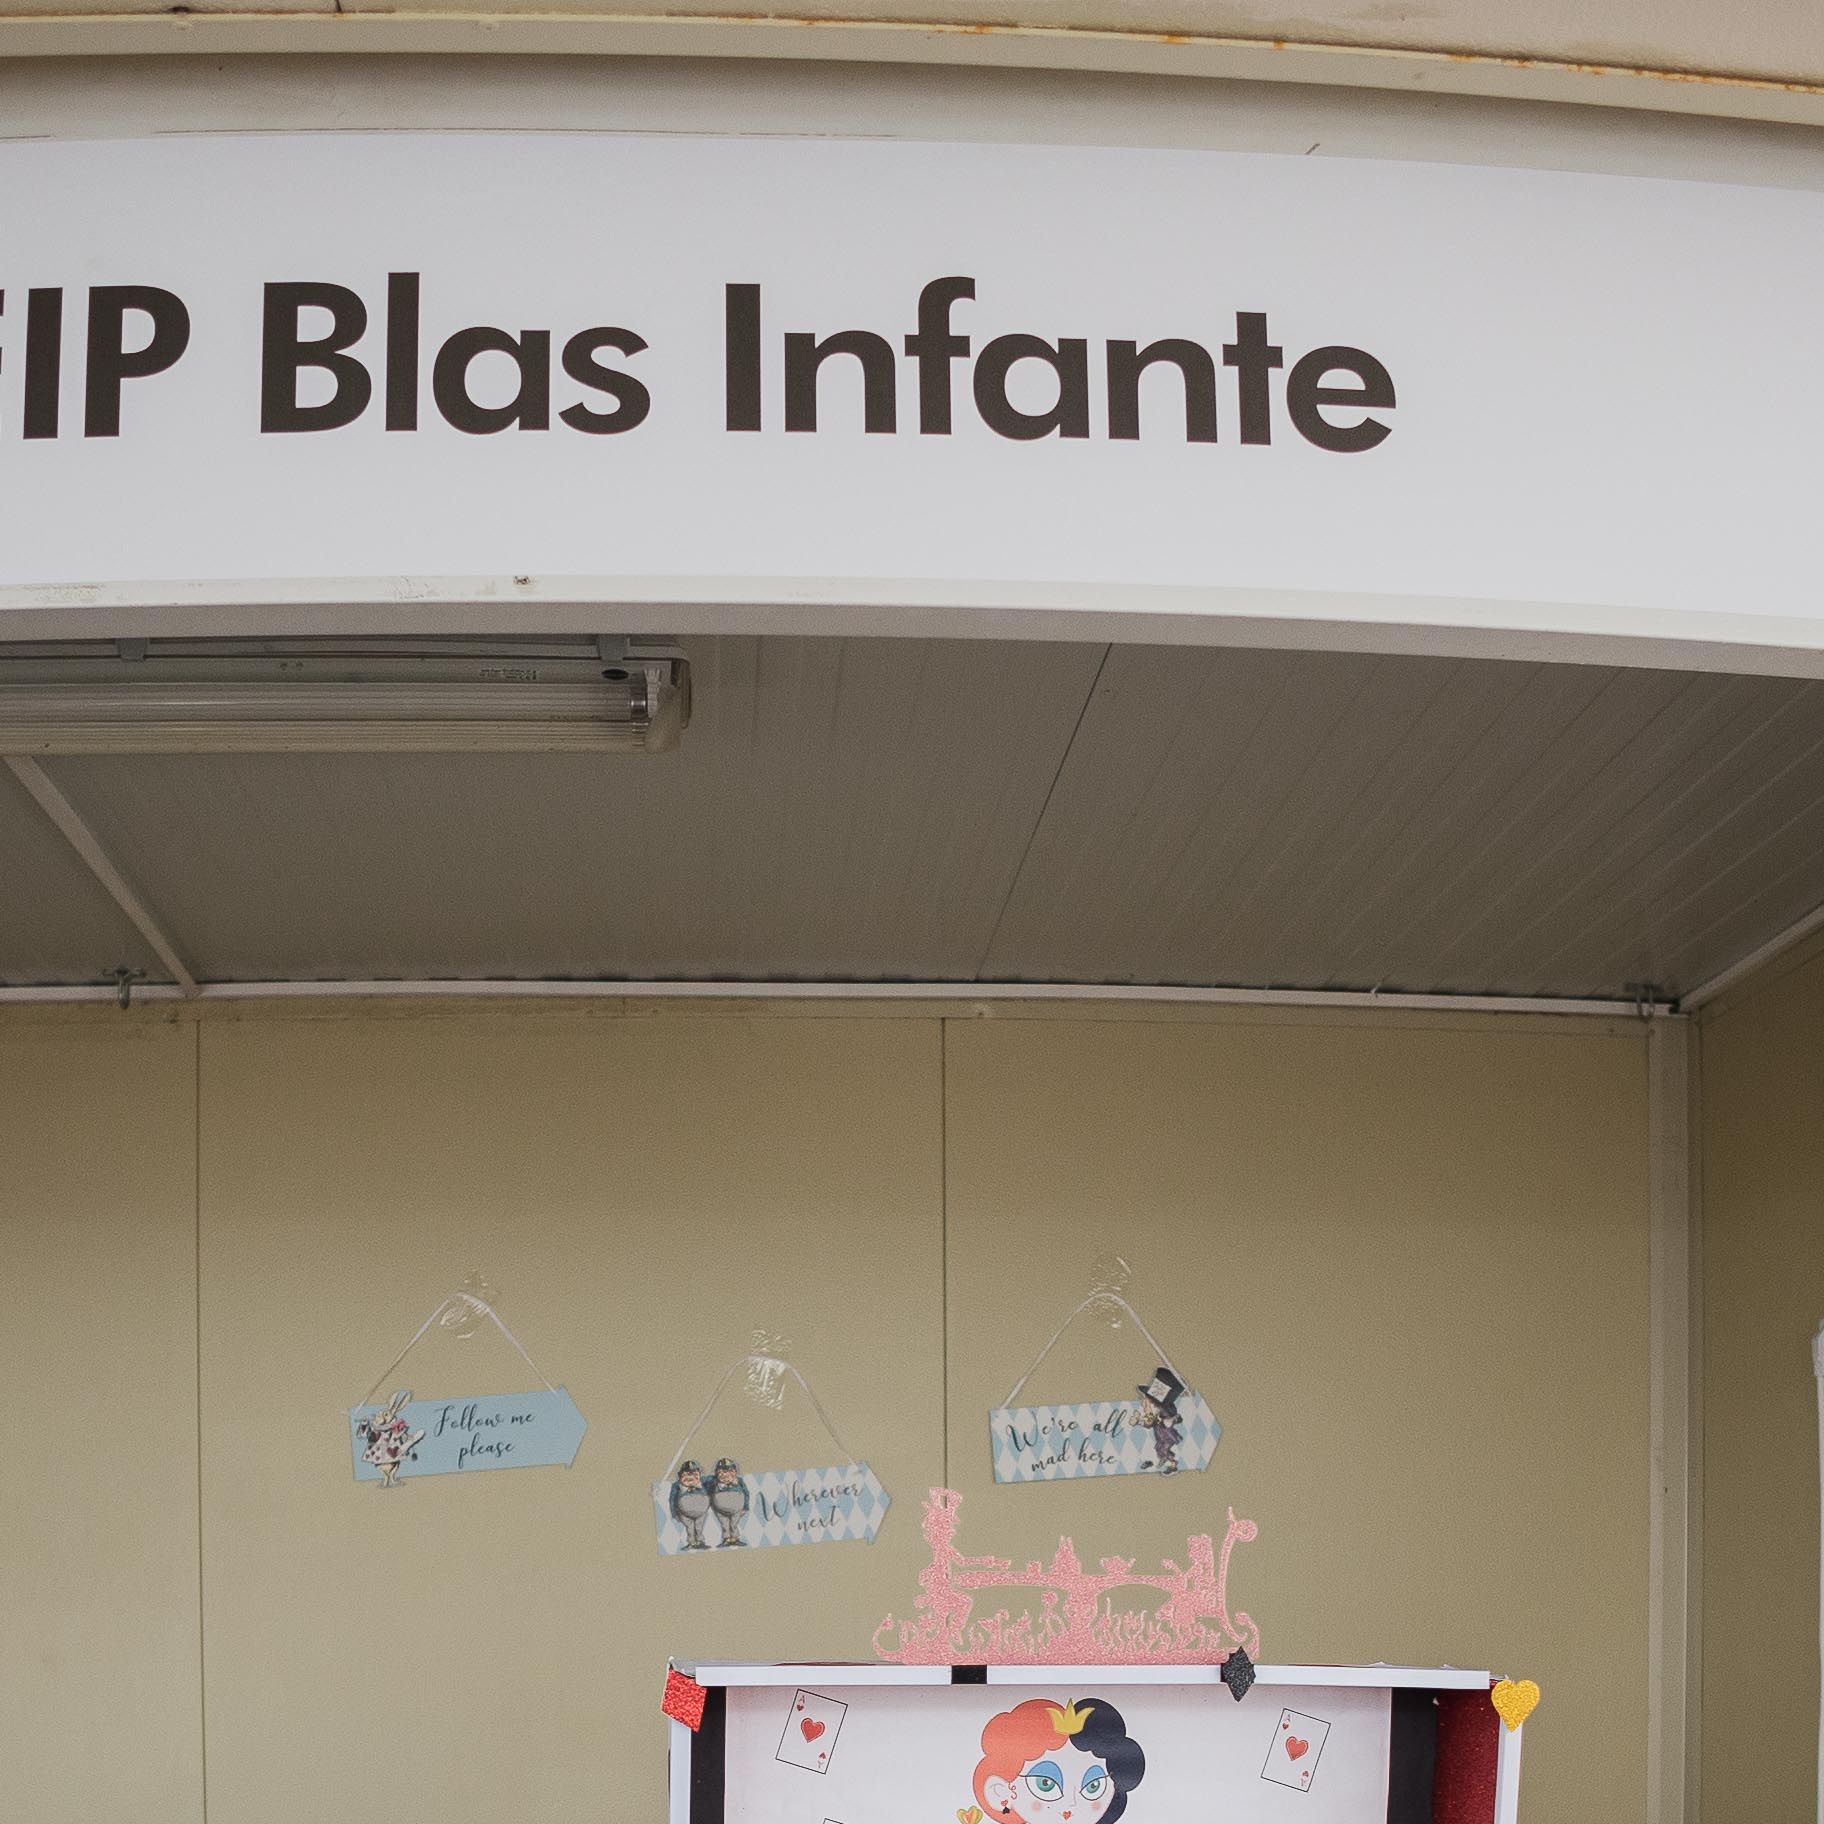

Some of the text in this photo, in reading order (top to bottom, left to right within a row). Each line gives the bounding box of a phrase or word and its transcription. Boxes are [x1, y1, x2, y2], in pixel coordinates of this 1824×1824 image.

[260, 272, 651, 435] Blas
[725, 276, 1396, 452] Infante
[434, 1404, 535, 1437] Follow me
[1006, 1409, 1127, 1452] We're all
[458, 1431, 516, 1469] please
[1031, 1437, 1119, 1472] mad here
[758, 1480, 862, 1522] Wherever
[797, 1504, 841, 1532] next
